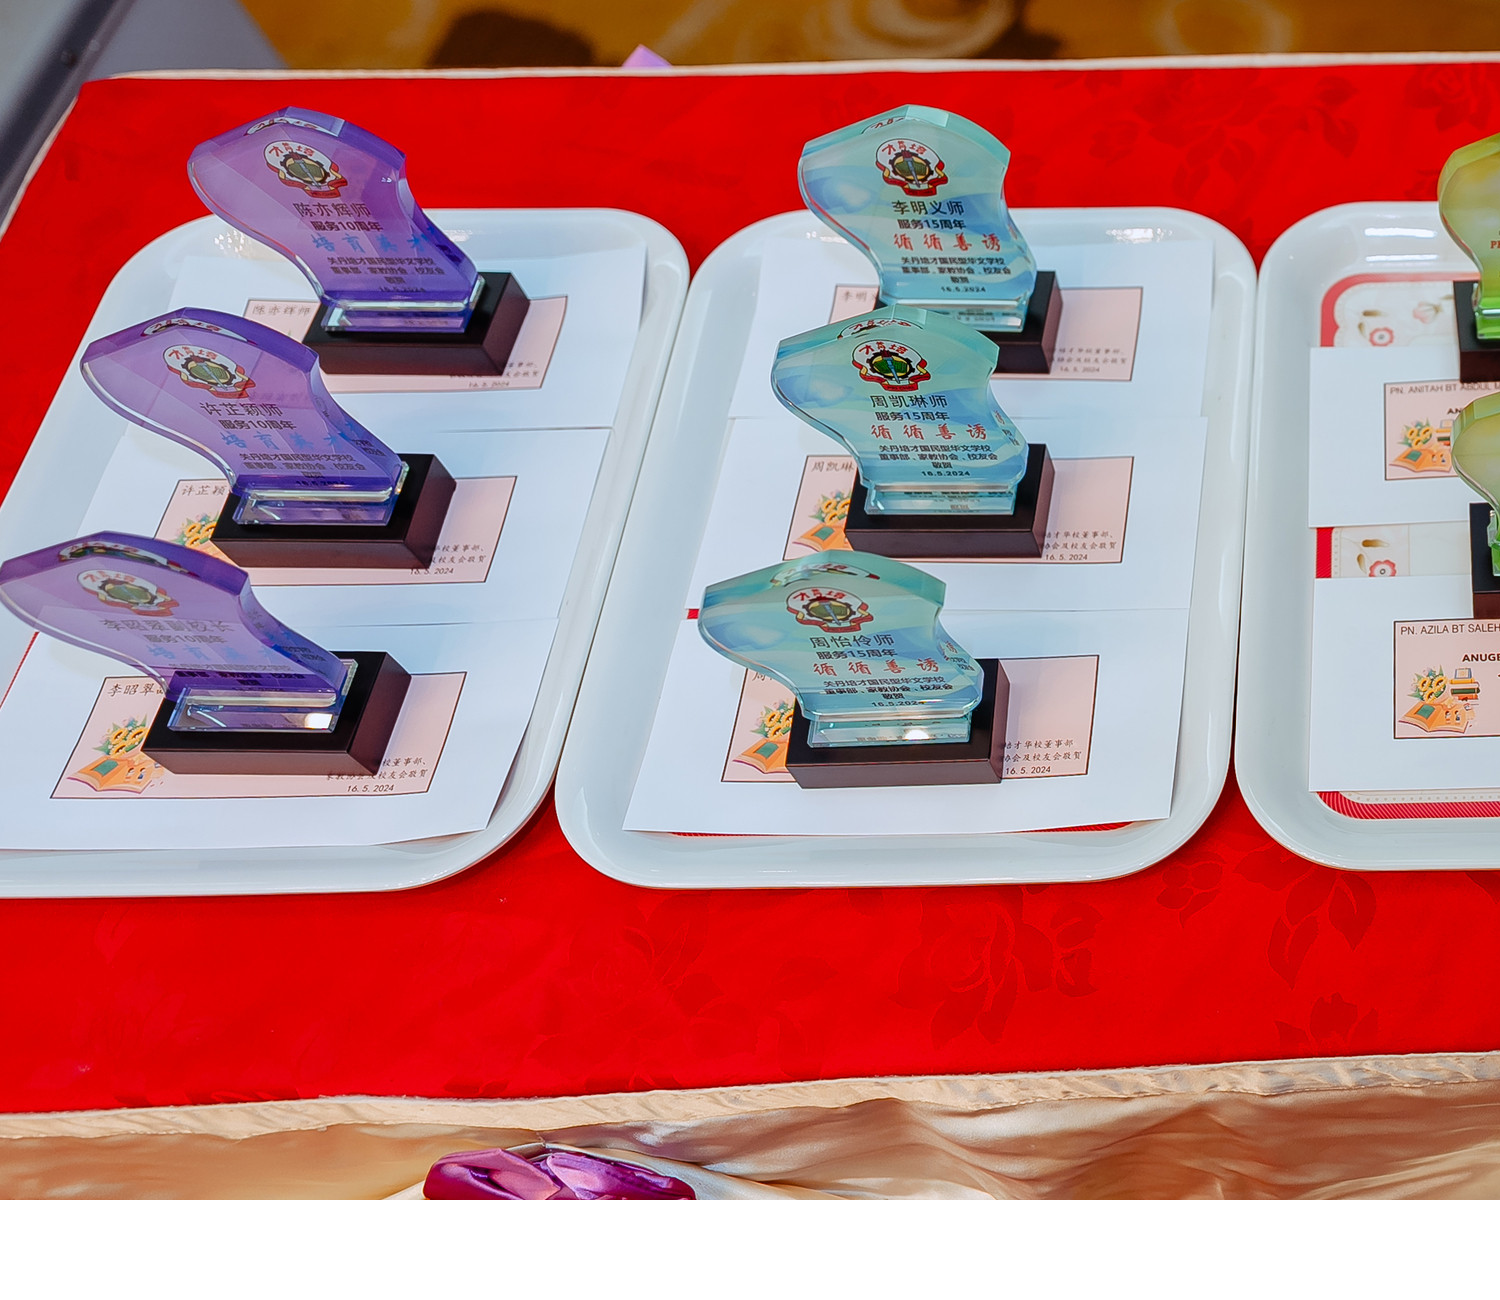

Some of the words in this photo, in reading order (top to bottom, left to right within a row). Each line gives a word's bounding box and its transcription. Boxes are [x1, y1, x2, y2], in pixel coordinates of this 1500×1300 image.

[892, 200, 965, 216] 李明义师
[310, 220, 383, 232] 服务10周年
[897, 219, 966, 230] 服务15周年
[893, 232, 1001, 252] 循循善诱
[870, 395, 948, 409] 周凯琳师
[875, 411, 950, 421] 服务15周年
[218, 419, 297, 430] 服务10周年
[870, 423, 987, 441] 循循善诱
[1400, 626, 1418, 635] PN.
[1420, 625, 1449, 635] AZILA
[1451, 624, 1466, 633] BT
[809, 634, 895, 649] 周怡伶师
[815, 648, 899, 660] 服务15周年
[813, 658, 940, 677] 循循善诱
